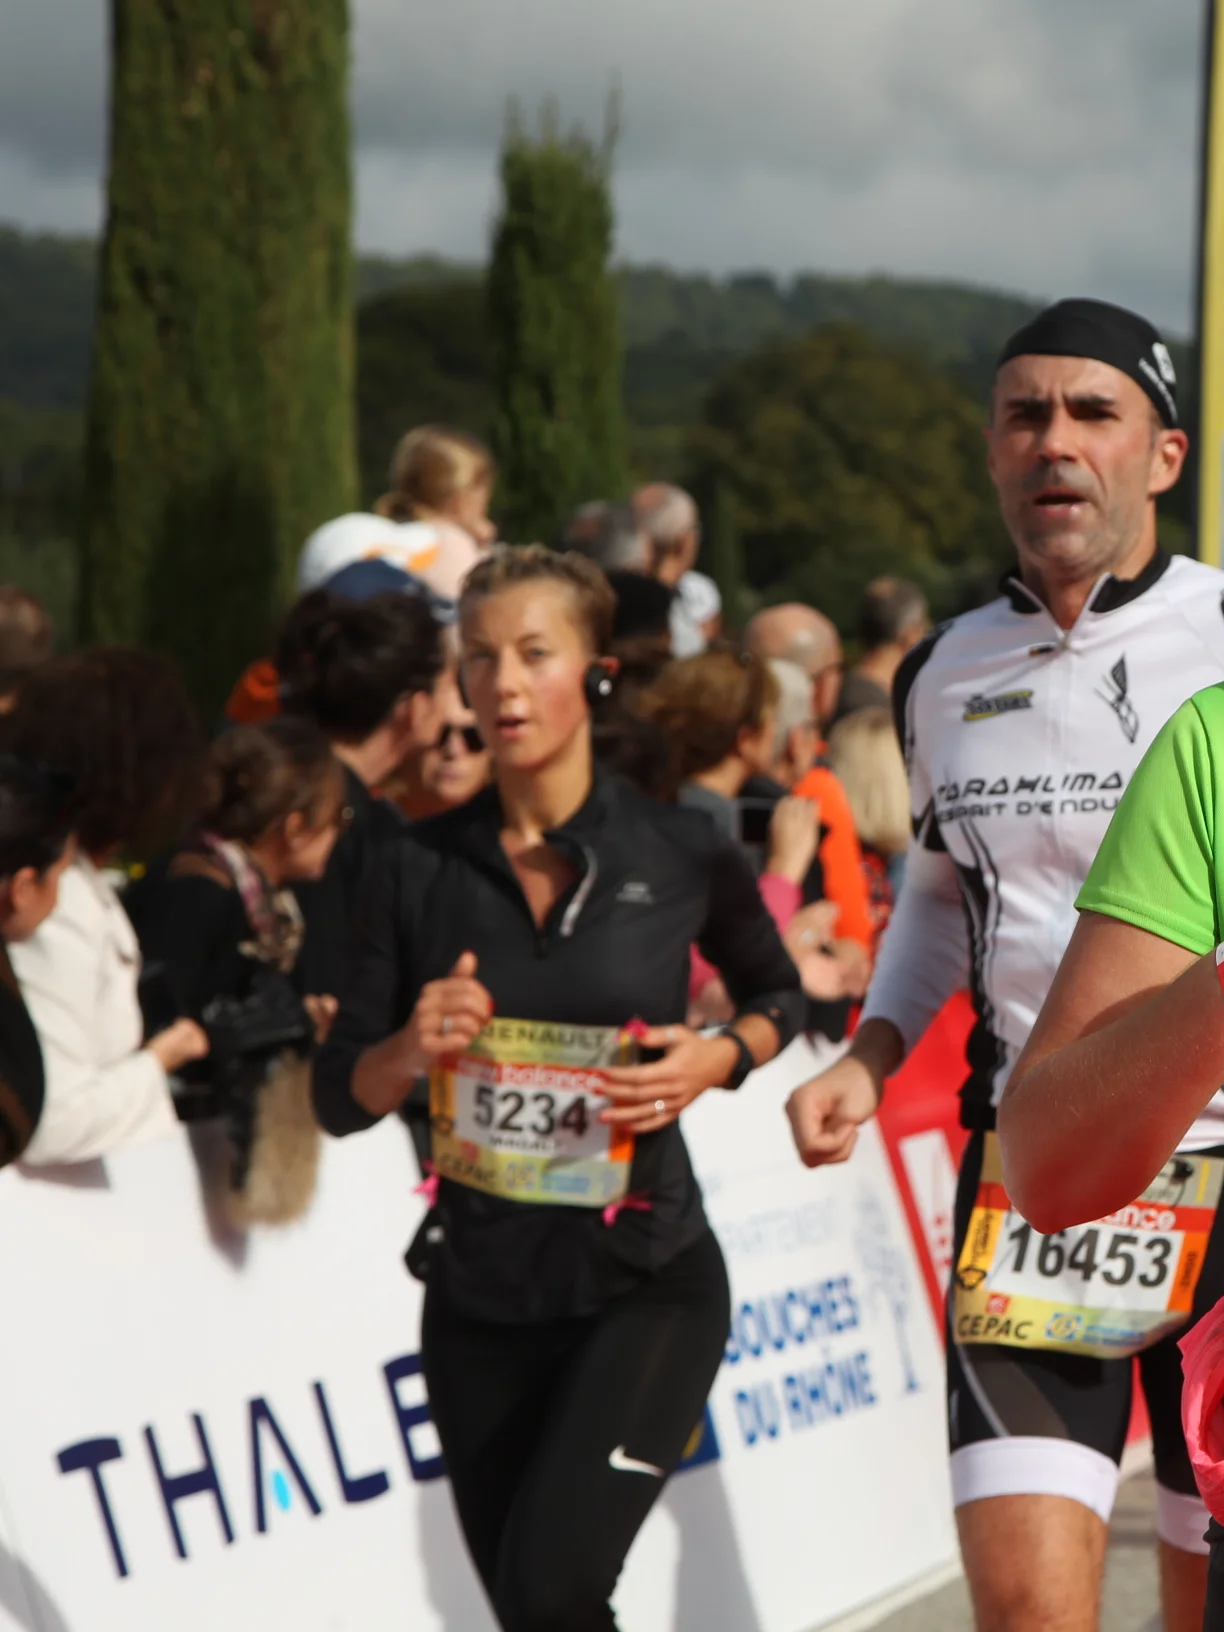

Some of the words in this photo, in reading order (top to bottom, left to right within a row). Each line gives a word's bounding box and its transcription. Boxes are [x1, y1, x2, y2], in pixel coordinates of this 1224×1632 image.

[1016, 797, 1119, 816] D'ENDU
[472, 1084, 589, 1138] 5234
[1008, 1222, 1172, 1288] 16453
[957, 1314, 1034, 1341] CEPAC
[734, 1378, 780, 1447] DU
[783, 1345, 877, 1434] RHÔNE
[56, 1352, 448, 1578] THALE
